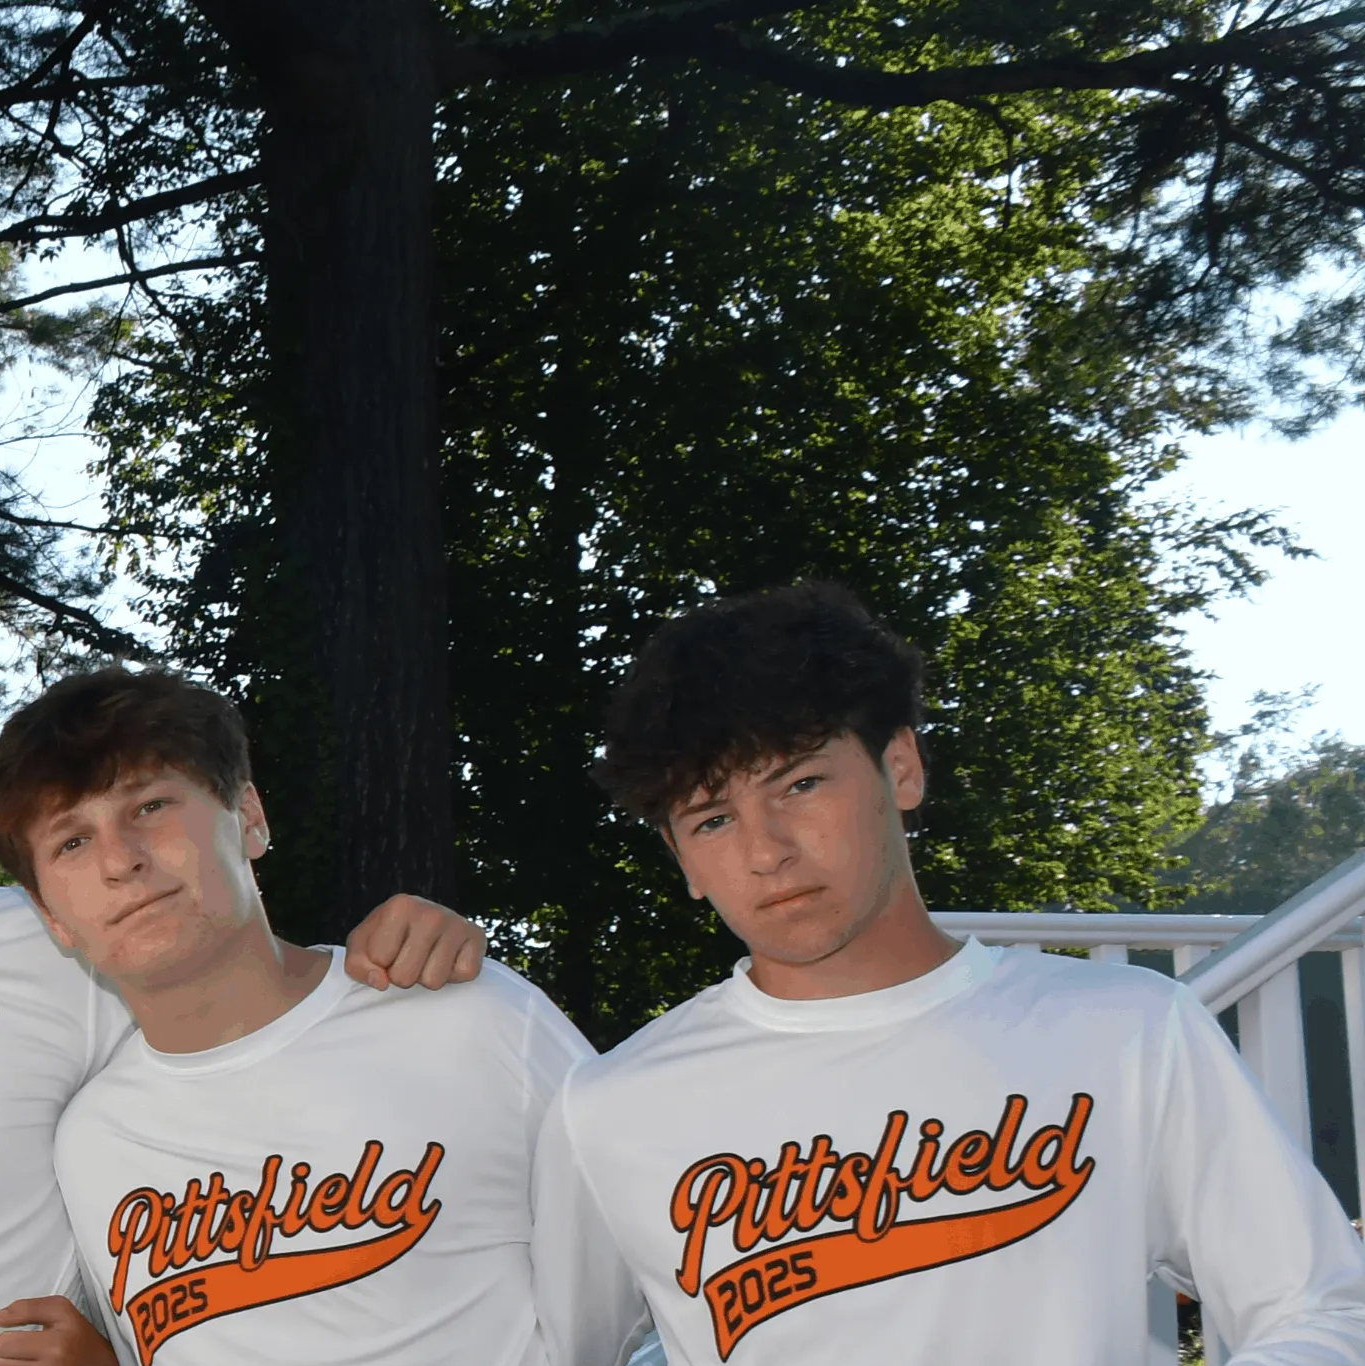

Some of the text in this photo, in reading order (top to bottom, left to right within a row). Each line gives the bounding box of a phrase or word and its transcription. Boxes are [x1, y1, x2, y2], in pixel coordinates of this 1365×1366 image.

[107, 1140, 445, 1316] Pittsfield
[670, 1092, 1096, 1298] Pittsfield
[136, 1278, 209, 1346] 2025
[716, 1251, 817, 1335] 2025
